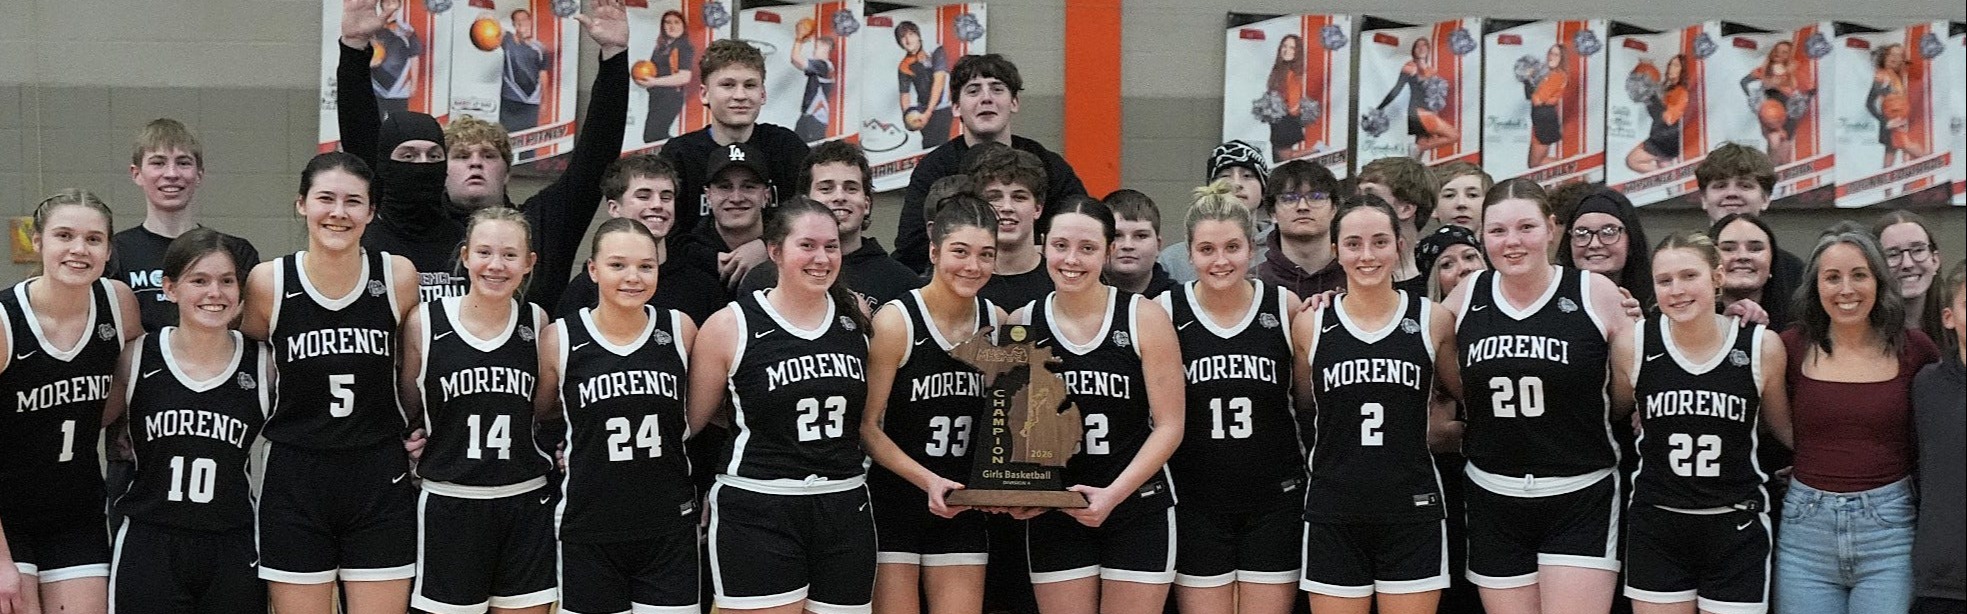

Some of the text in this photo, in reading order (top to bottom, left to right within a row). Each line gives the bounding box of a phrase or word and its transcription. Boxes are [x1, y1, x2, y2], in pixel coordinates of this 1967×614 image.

[729, 145, 745, 161] LA
[288, 328, 390, 362] MORENCI
[1467, 335, 1569, 367] MORENCI
[440, 366, 535, 402] MORENCI
[578, 370, 678, 408] MORENCI
[766, 353, 866, 391] MORENCI
[1055, 371, 1131, 399] RENCI
[1323, 359, 1421, 392] MORENCI
[328, 374, 355, 418] 5
[1489, 376, 1545, 418] 20
[1646, 390, 1747, 422] MORENCI
[145, 409, 248, 448] MORENCI
[467, 414, 512, 460] 14
[606, 414, 662, 461] 24
[796, 396, 848, 441] 23
[925, 415, 972, 457] 33
[992, 389, 1005, 464] CHAMPION
[1210, 397, 1253, 439] 13
[1360, 403, 1385, 446] 2
[59, 420, 76, 462] 1
[1031, 450, 1053, 458] 2026
[1669, 433, 1722, 477] 22
[168, 456, 217, 503] 10
[982, 470, 1051, 479] Girls Basketball
